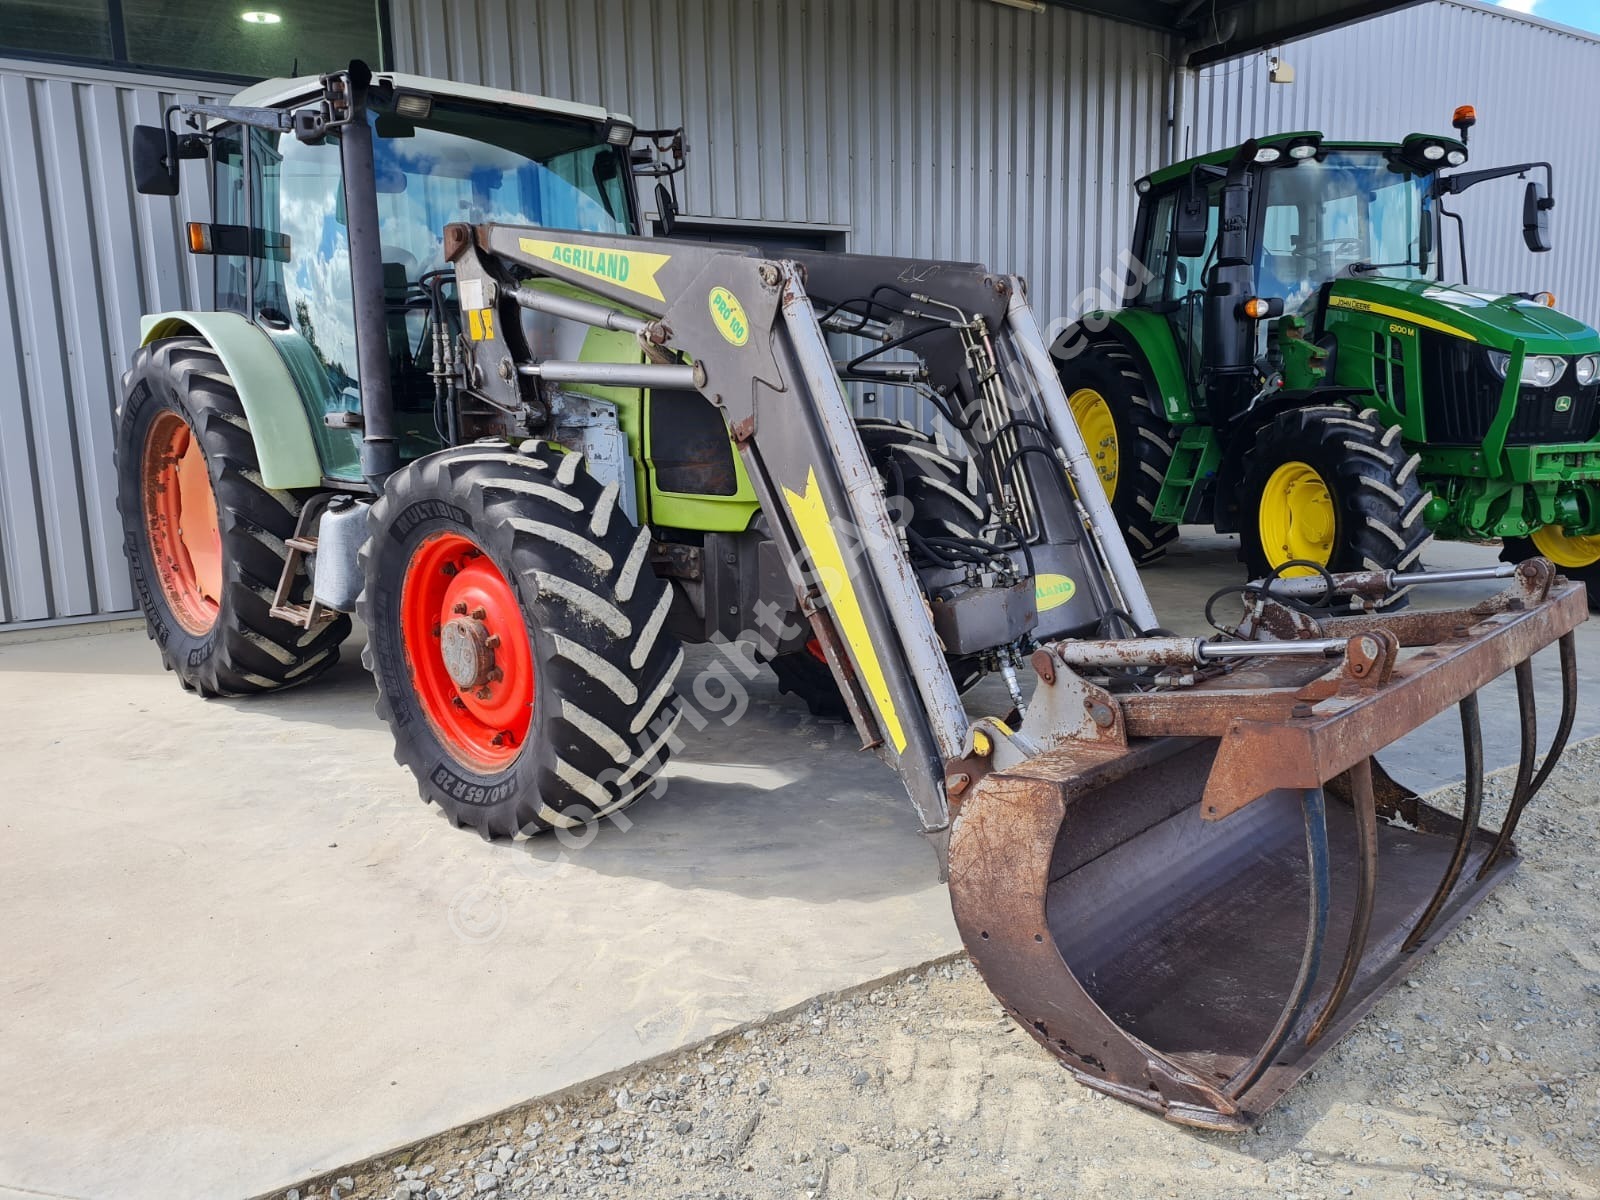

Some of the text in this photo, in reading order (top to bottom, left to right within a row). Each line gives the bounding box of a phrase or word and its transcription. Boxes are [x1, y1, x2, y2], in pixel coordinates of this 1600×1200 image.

[552, 245, 630, 283] AGRILAND
[713, 293, 745, 339] PRO 100
[1336, 298, 1371, 311] JOHN DEERE
[1407, 328, 1414, 336] M
[395, 501, 465, 535] MULTIBIB
[434, 769, 517, 804] 440/65 R 28
